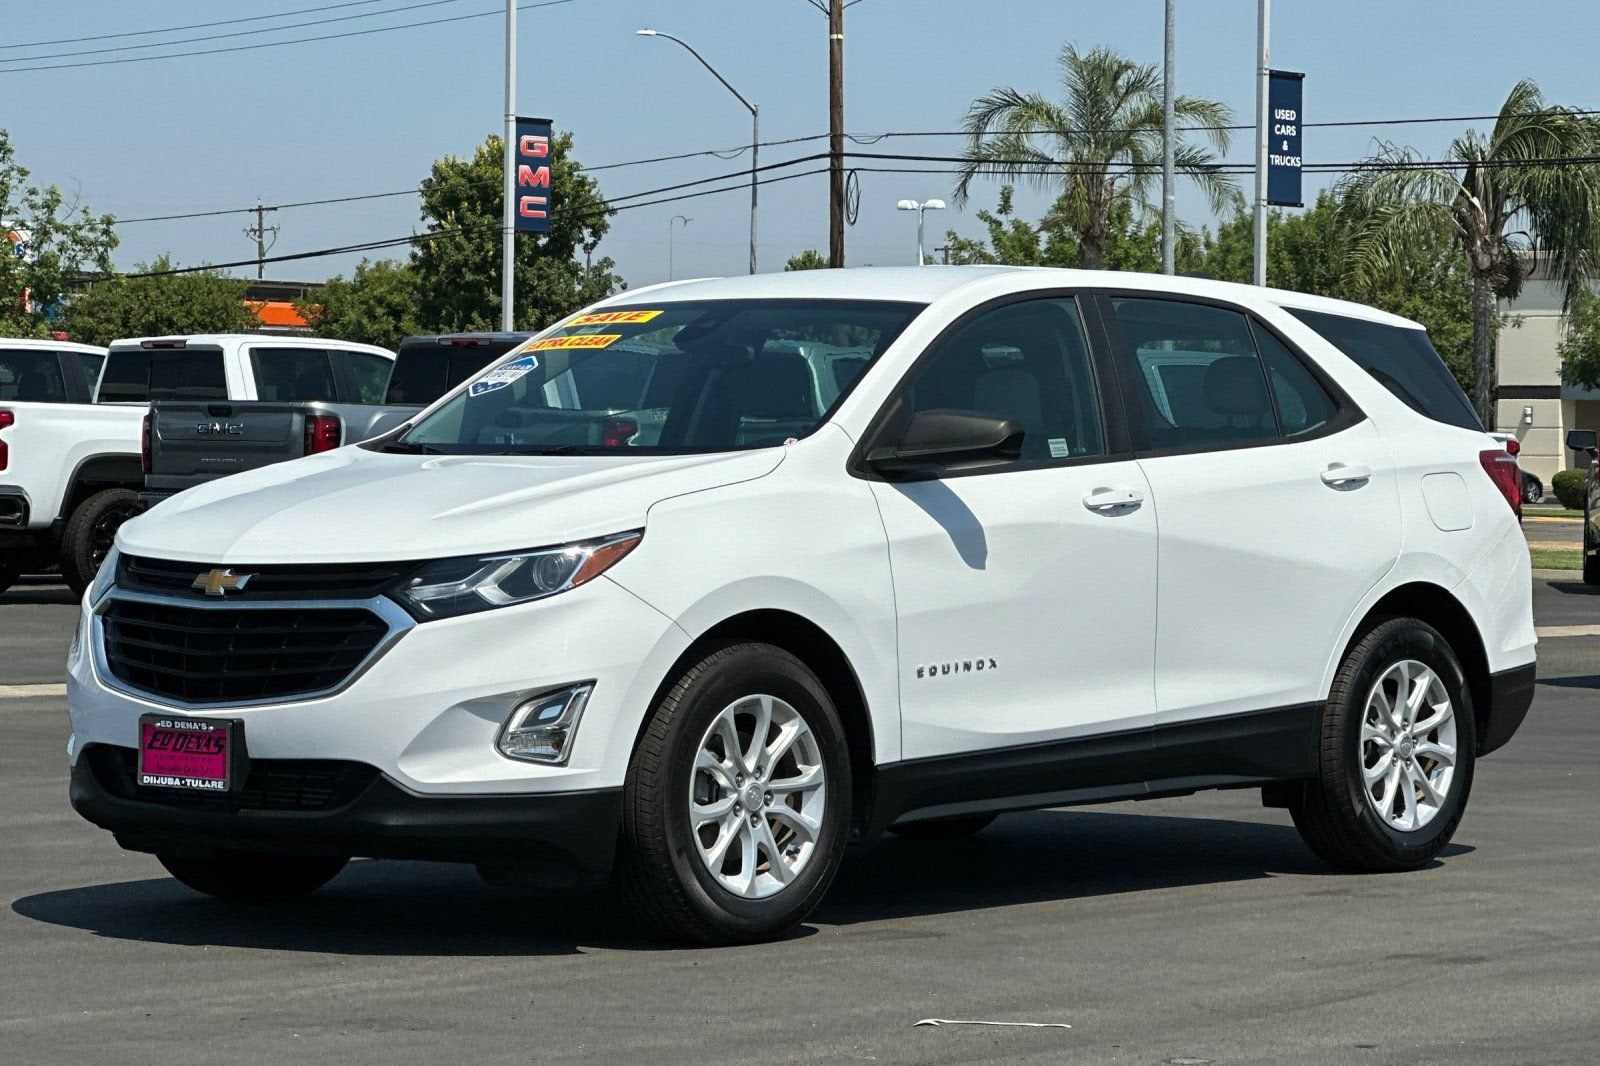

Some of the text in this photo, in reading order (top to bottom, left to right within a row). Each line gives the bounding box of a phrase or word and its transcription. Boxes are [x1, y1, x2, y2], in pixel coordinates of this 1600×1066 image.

[1275, 109, 1296, 120] USED
[1275, 124, 1296, 136] CARS
[1282, 140, 1288, 150] &
[1270, 154, 1301, 167] TRUCKS
[518, 134, 550, 218] GMC
[574, 312, 653, 324] SAVE
[197, 423, 243, 434] GMC
[916, 658, 997, 679] EQUINOX
[160, 720, 207, 730] ED DENA'S
